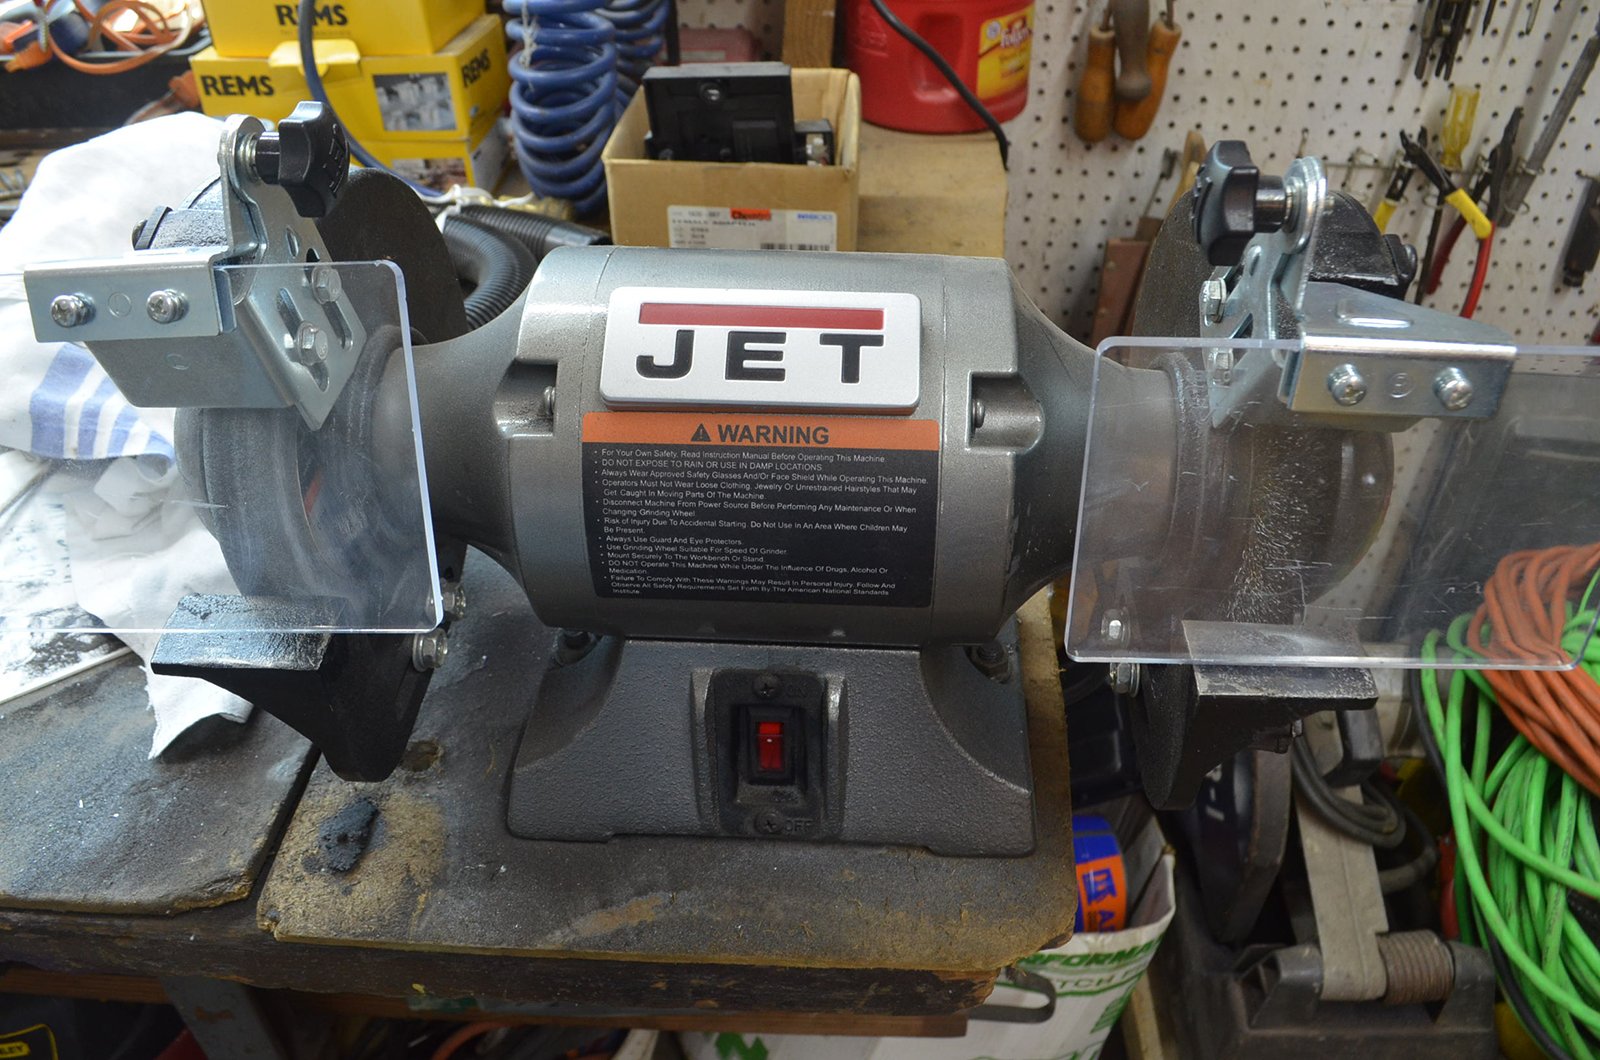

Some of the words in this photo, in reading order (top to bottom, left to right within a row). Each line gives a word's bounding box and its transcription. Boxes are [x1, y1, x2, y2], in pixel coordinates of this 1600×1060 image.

[275, 4, 348, 26] RMS
[461, 48, 491, 88] REMS
[201, 75, 274, 96] REMS
[636, 329, 884, 384] JET
[718, 424, 830, 445] WARNING
[616, 449, 633, 457] Your
[635, 449, 652, 457] Own
[743, 452, 770, 460] Manual
[798, 454, 834, 463] Operating
[776, 463, 822, 471] LOCATIONS
[650, 471, 684, 479] Approved
[687, 472, 710, 480] Safety
[712, 472, 741, 480] Glasses
[840, 475, 876, 484] Operating
[602, 479, 638, 488] Operators
[696, 481, 718, 489] Loose
[755, 483, 782, 492] Jewelry
[796, 484, 842, 492] Unrestrained
[845, 485, 881, 494] Hairstyles
[901, 486, 917, 495] May
[620, 490, 647, 498] Caught
[658, 490, 684, 498] Moving
[645, 499, 675, 507] Machine
[698, 500, 721, 508] Power
[724, 501, 749, 509] Source
[777, 503, 817, 512] Performing
[819, 504, 833, 512] Any
[603, 508, 637, 517] Changing
[639, 509, 670, 517] Grinding
[631, 519, 650, 527] Injury
[834, 523, 857, 531] Where
[860, 524, 890, 532] Children
[892, 525, 908, 533] May
[632, 553, 662, 561] Securely
[724, 547, 747, 555] Speed
[641, 561, 669, 569] Operate
[784, 820, 813, 832] OFF
